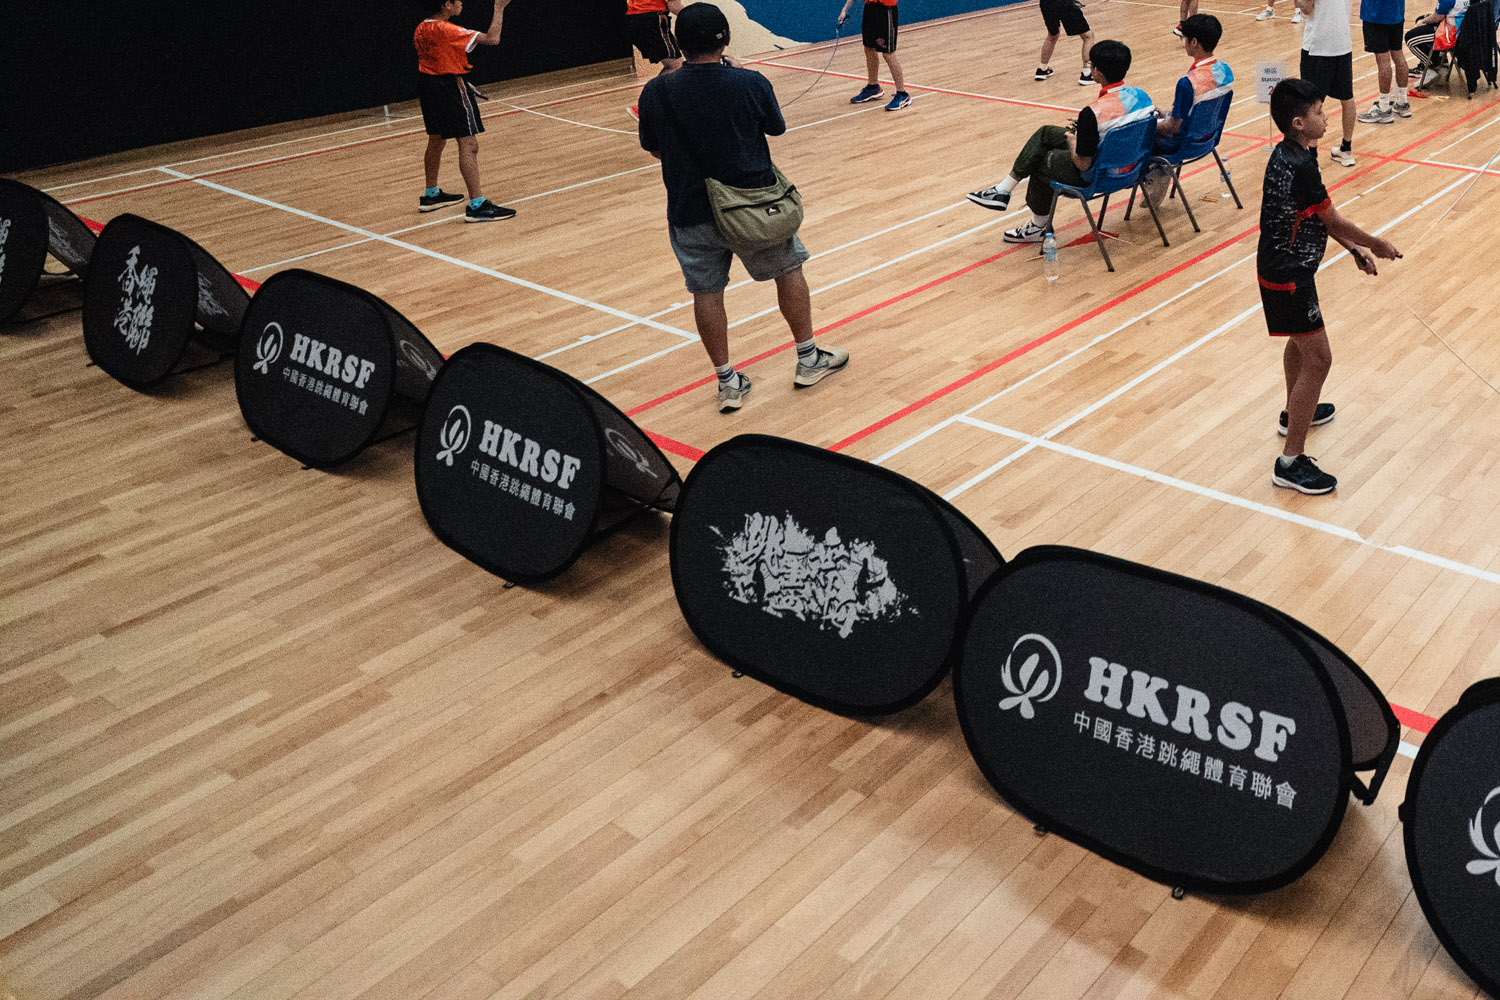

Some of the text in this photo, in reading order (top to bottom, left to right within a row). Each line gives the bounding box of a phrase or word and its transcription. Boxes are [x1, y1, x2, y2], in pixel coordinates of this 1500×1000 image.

[1268, 85, 1274, 95] 2
[290, 333, 376, 389] HKRSF
[479, 420, 581, 489] HKRSF
[470, 458, 577, 521] 中國香港跳繩體育聯會
[1083, 656, 1297, 762] HKRSF
[1073, 710, 1297, 810] 中國香港跳繩體育聯會
